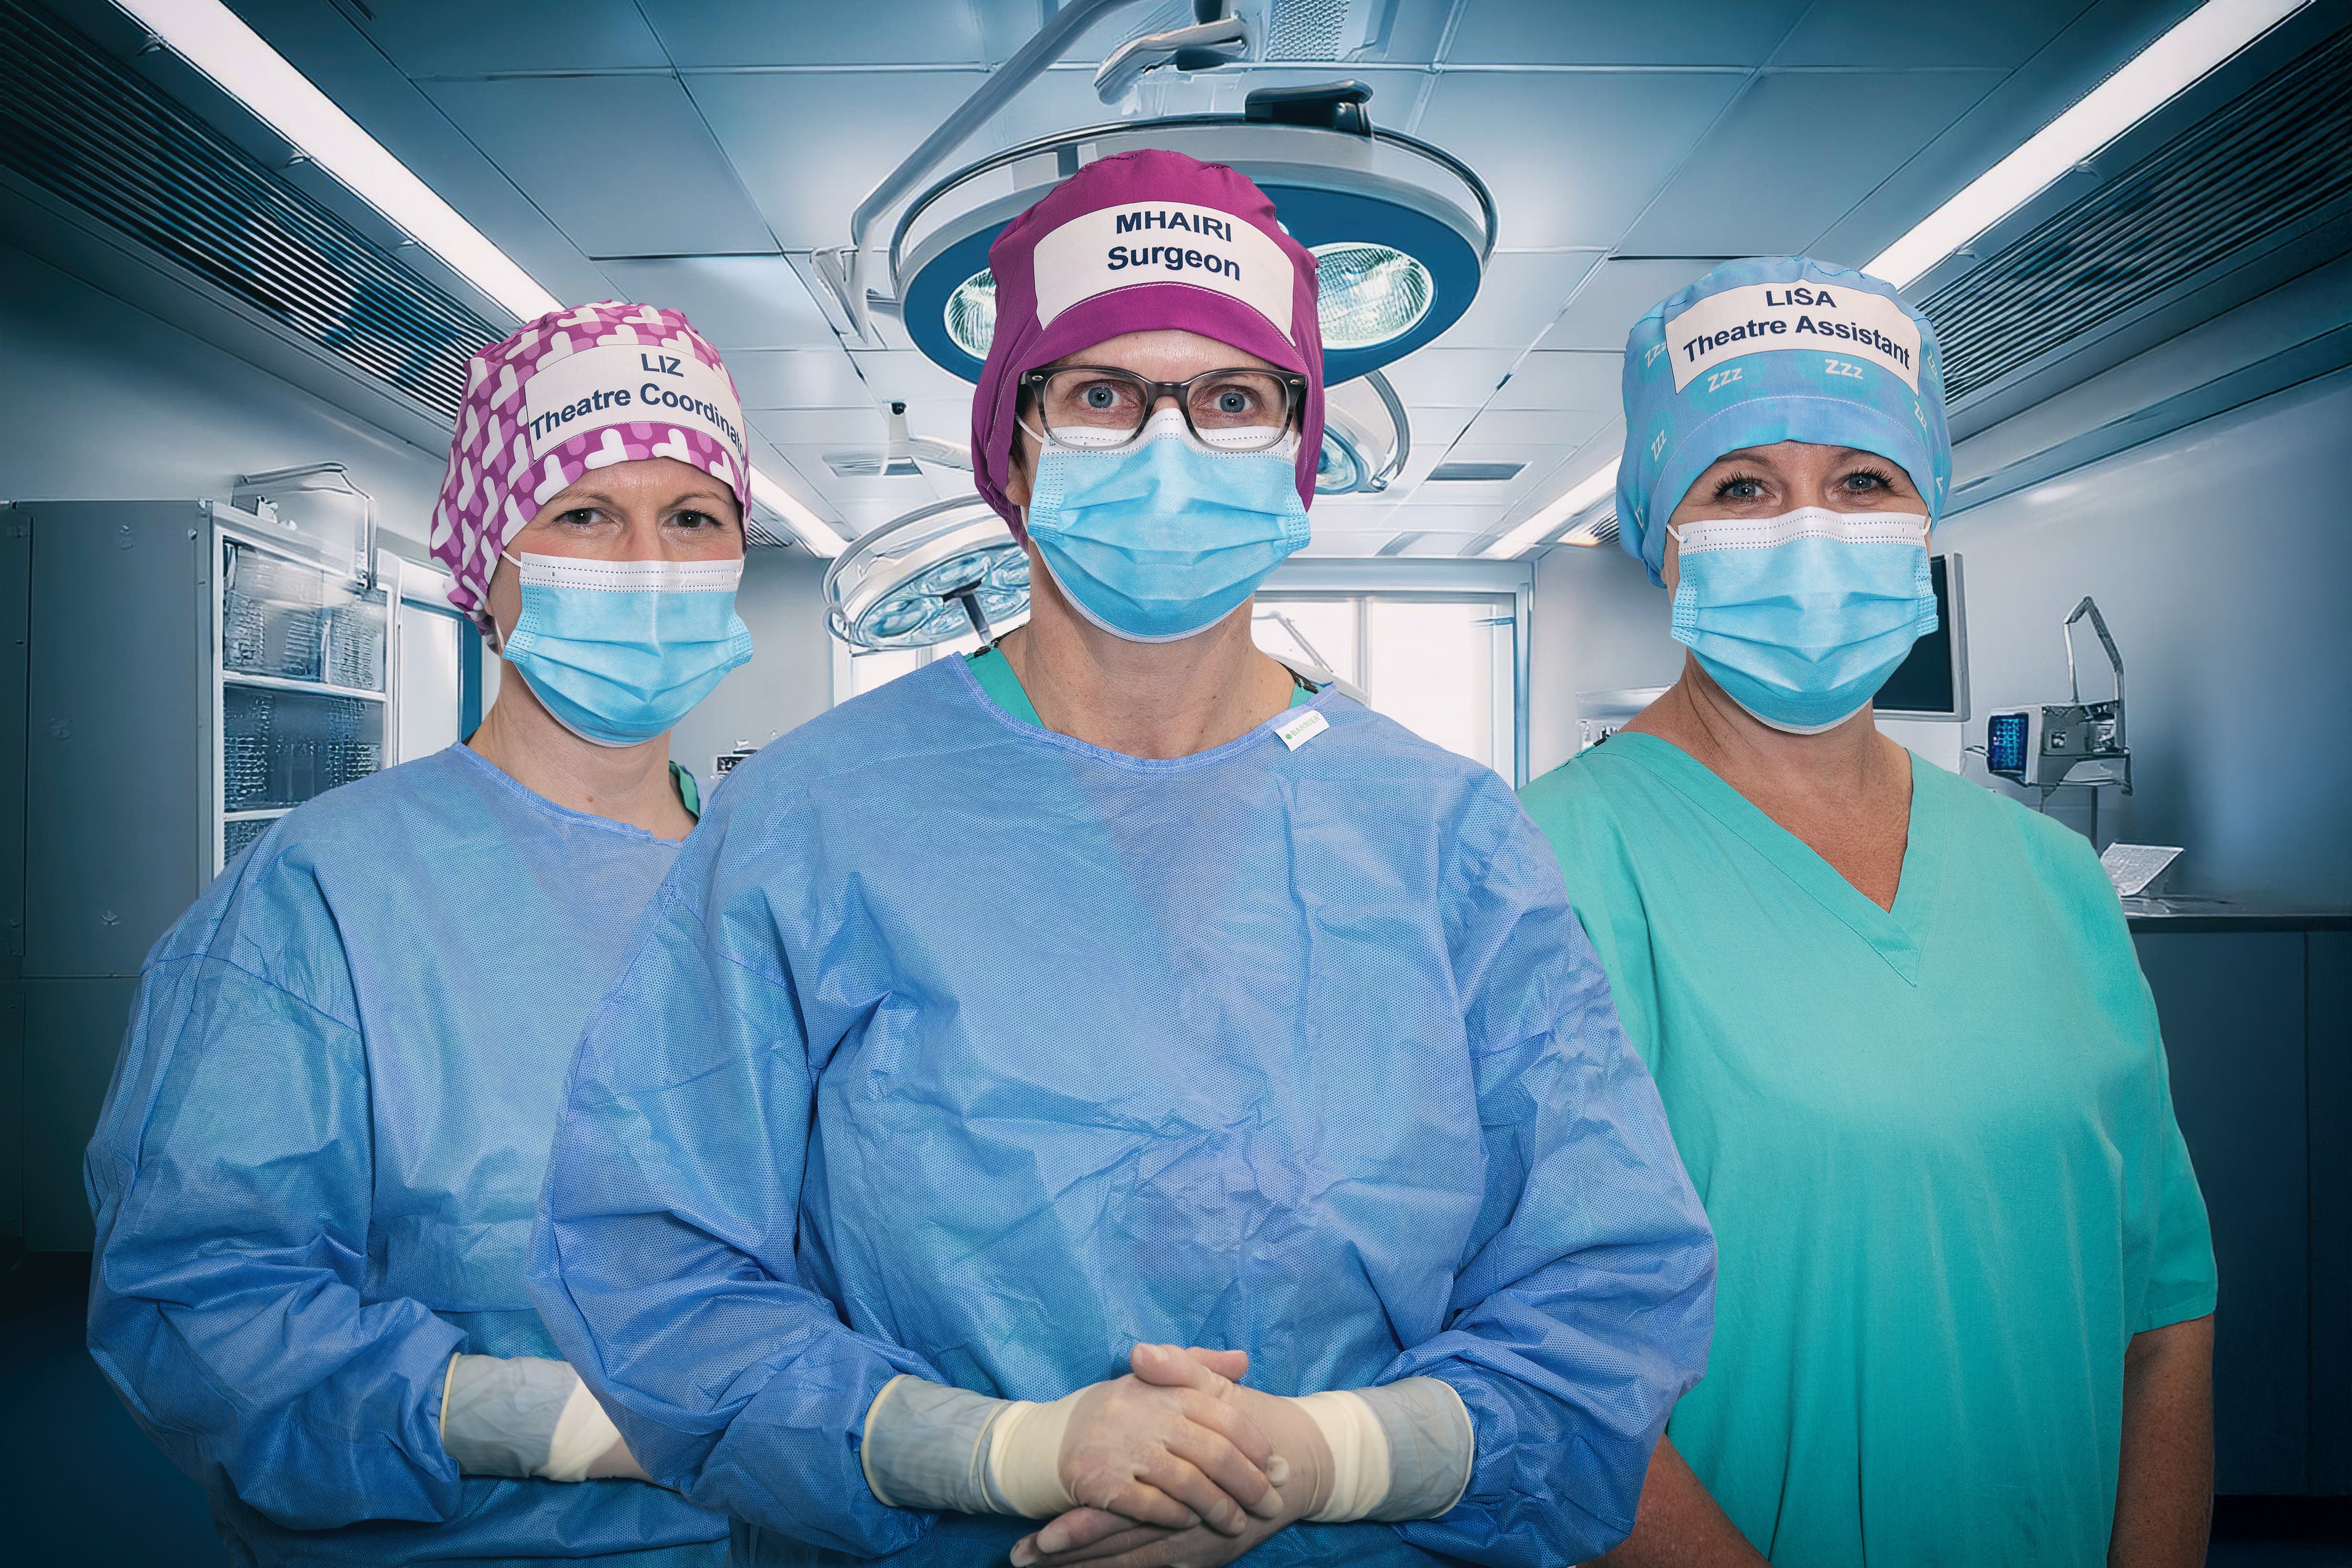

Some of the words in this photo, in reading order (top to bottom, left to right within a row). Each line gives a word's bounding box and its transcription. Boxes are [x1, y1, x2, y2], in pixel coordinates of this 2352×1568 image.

[1116, 211, 1232, 242] MHAIRI
[1107, 246, 1240, 281] Surgeon
[1766, 288, 1837, 308] LISA
[1683, 320, 1787, 363] Theatre
[1795, 315, 1910, 371] Assistant
[641, 353, 684, 377] LIZ
[530, 389, 631, 441] Theatre
